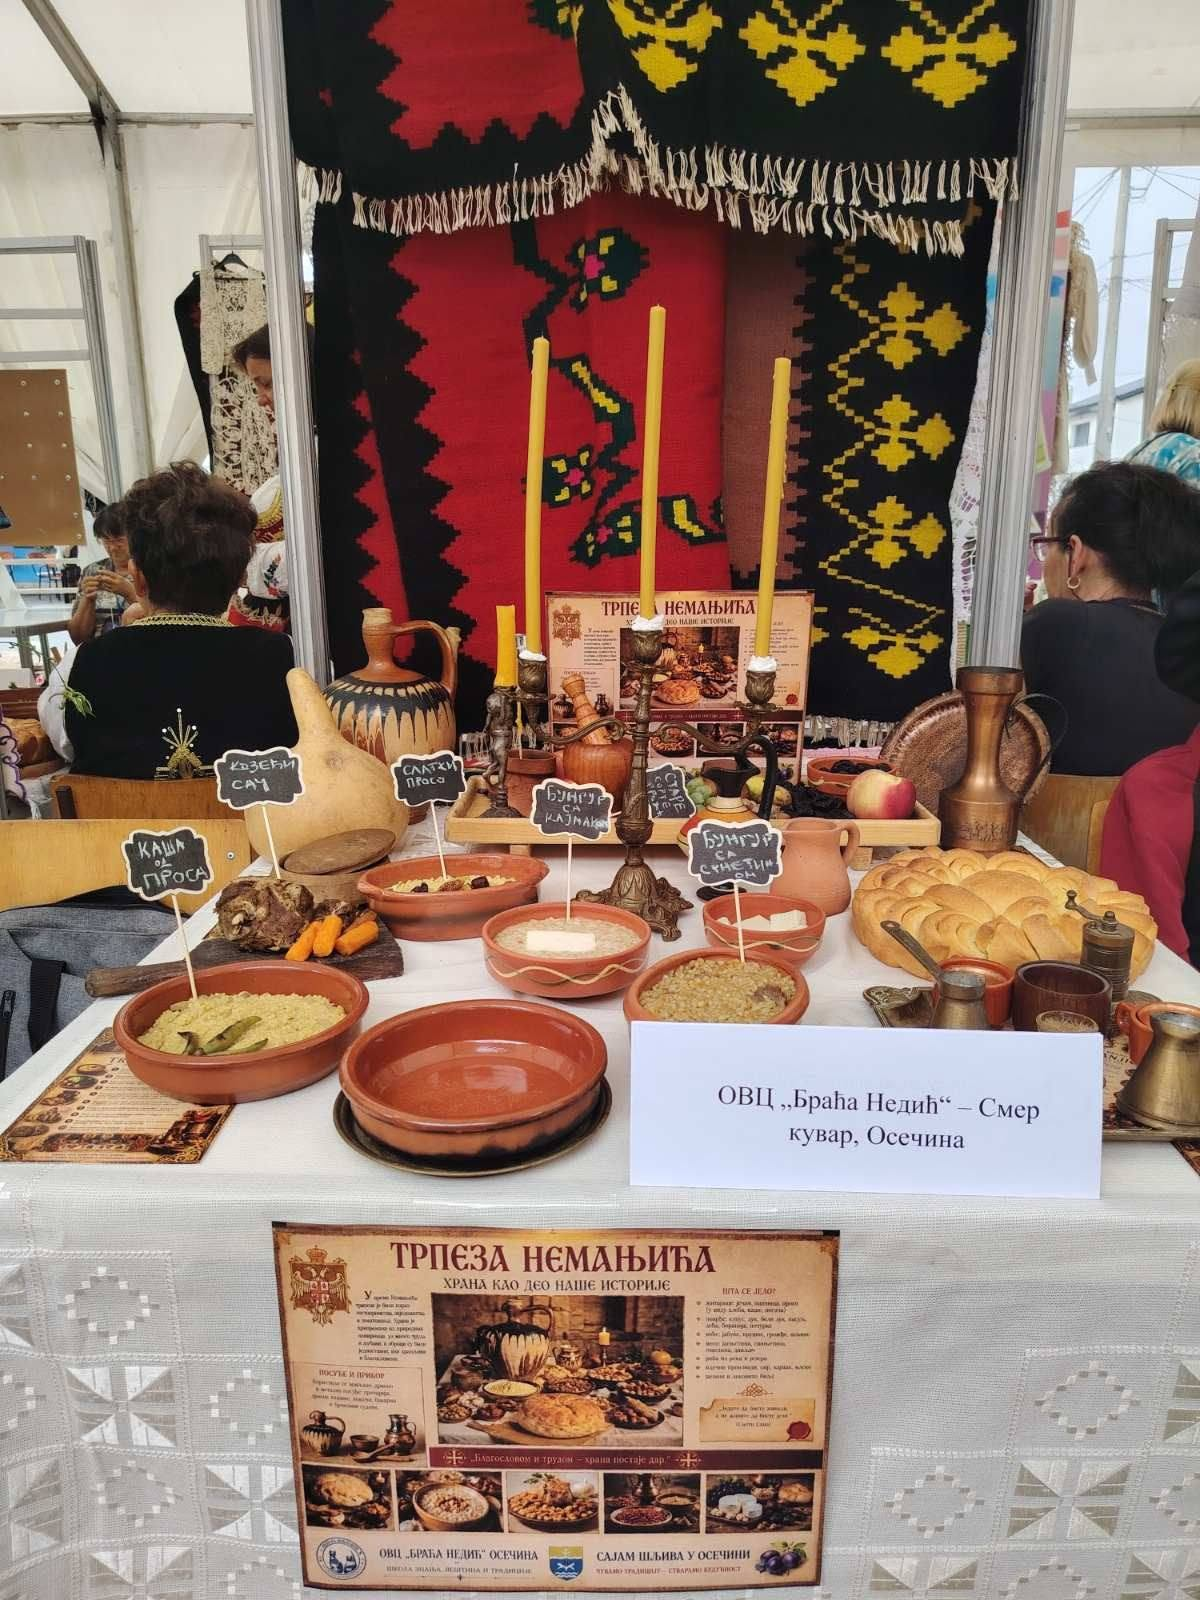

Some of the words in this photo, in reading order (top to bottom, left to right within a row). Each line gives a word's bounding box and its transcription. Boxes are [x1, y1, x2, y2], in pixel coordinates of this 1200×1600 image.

[602, 601, 657, 616] ТРПЕ
[665, 600, 756, 616] НЕМАЊИЋА
[138, 838, 185, 859] КАША
[143, 866, 209, 890] ПРОСА
[718, 1085, 774, 1111] ОВЦ
[978, 1097, 1040, 1125] Смер
[789, 1127, 860, 1149] кувар,
[867, 1125, 965, 1149] Осечина
[391, 1242, 510, 1271] ТРПЕЗА
[522, 1245, 716, 1273] НЕМАЊИЋА
[443, 1278, 487, 1290] ХРАНА
[492, 1279, 519, 1291] КАО
[524, 1280, 550, 1292] ДЕО
[555, 1279, 596, 1291] НАШЕ
[601, 1279, 671, 1291] ИСТОРИЈЕ
[379, 1548, 402, 1560] ОВЦ
[489, 1549, 538, 1561] ОСЕЧИНА
[596, 1551, 635, 1562] САЈАМ
[638, 1551, 684, 1561] ШЉИВА
[687, 1551, 695, 1561] У
[697, 1549, 750, 1561] ОСЕЧИНИ
